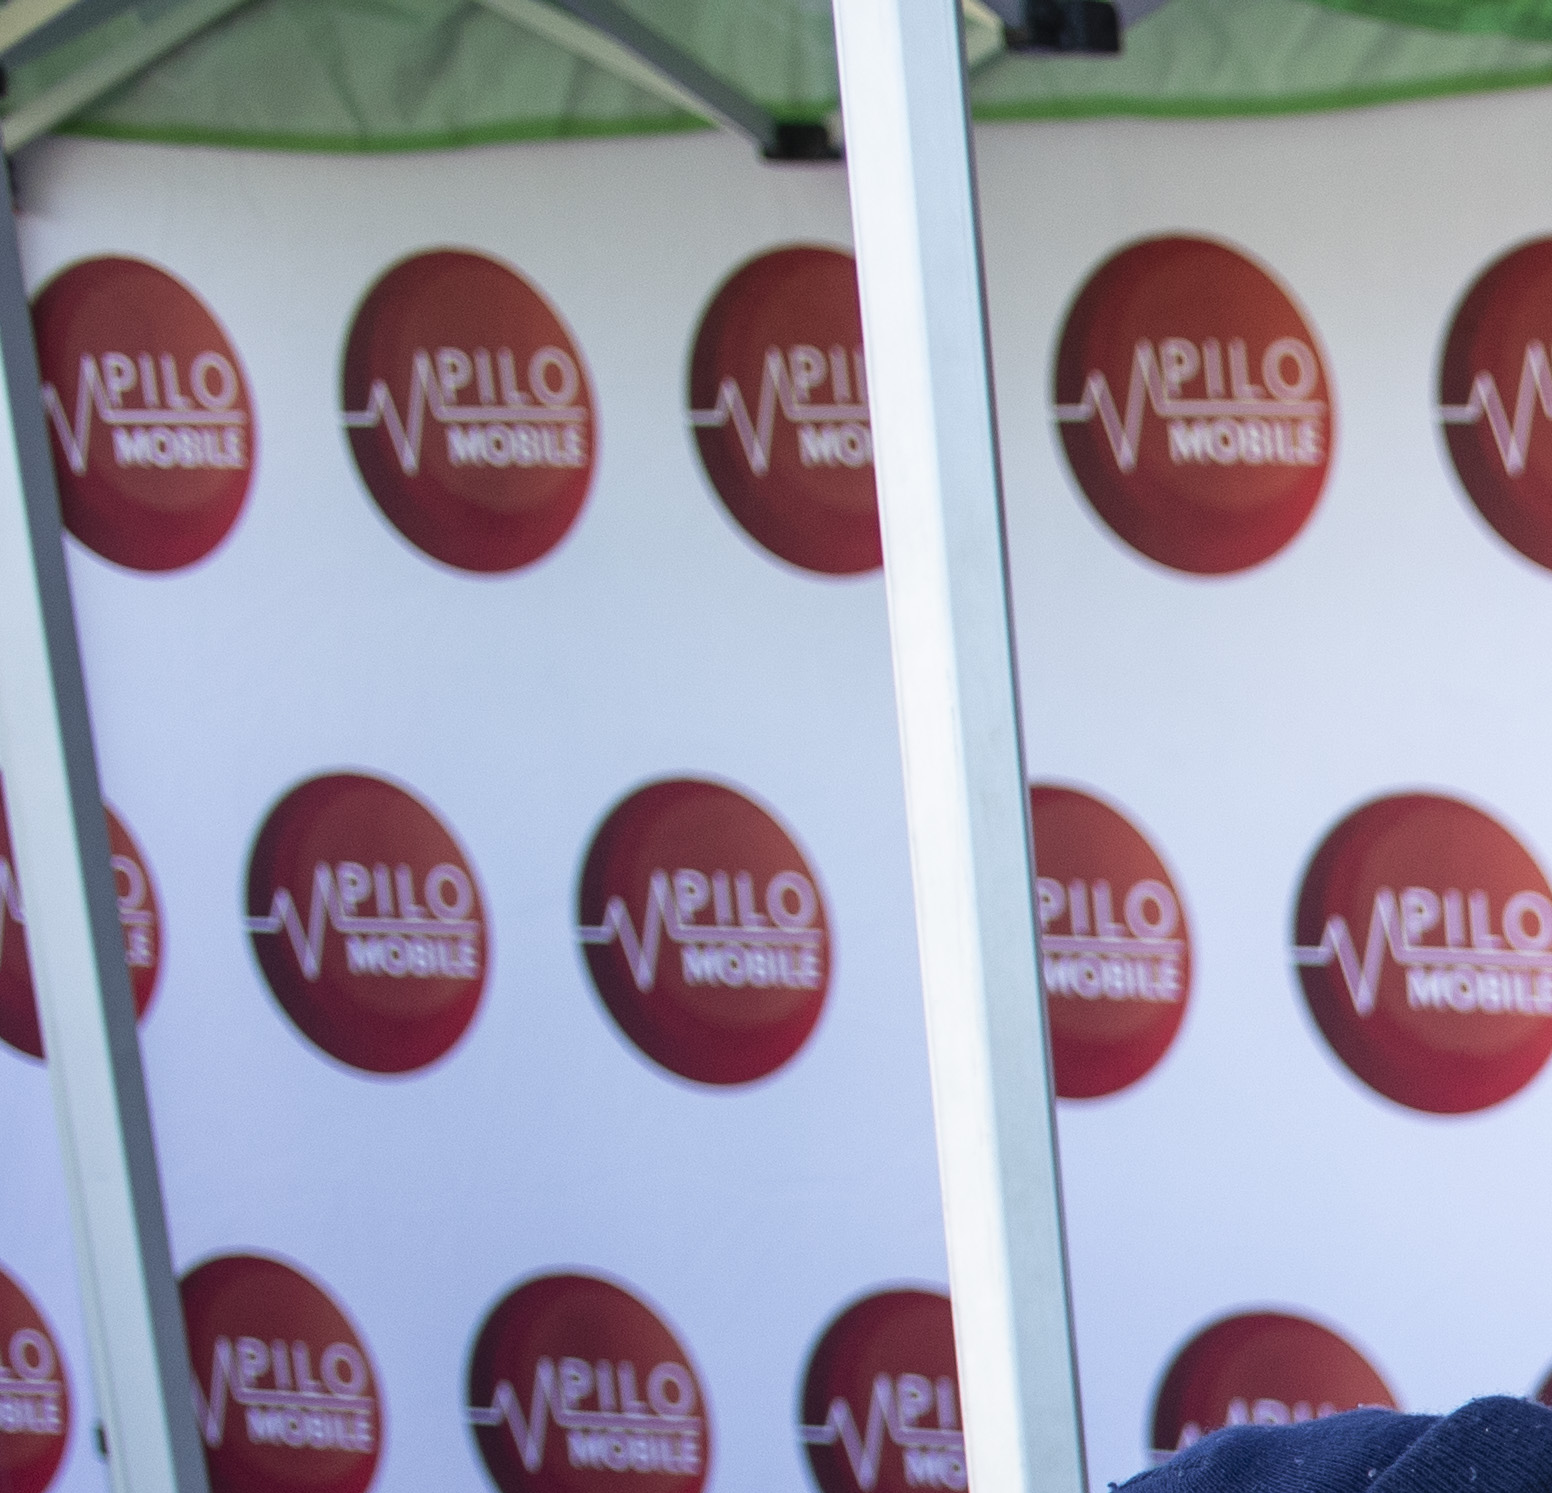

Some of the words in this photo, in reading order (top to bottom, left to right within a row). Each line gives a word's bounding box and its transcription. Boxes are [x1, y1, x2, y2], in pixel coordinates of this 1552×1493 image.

[113, 425, 247, 470] MOBILE
[448, 425, 587, 468] MOBILE
[1168, 417, 1323, 466] MOBILE
[344, 937, 478, 979] MOBILE
[682, 945, 821, 990] MOBILE
[244, 1404, 374, 1453] MOBILE
[567, 1429, 699, 1476] MOBILE
